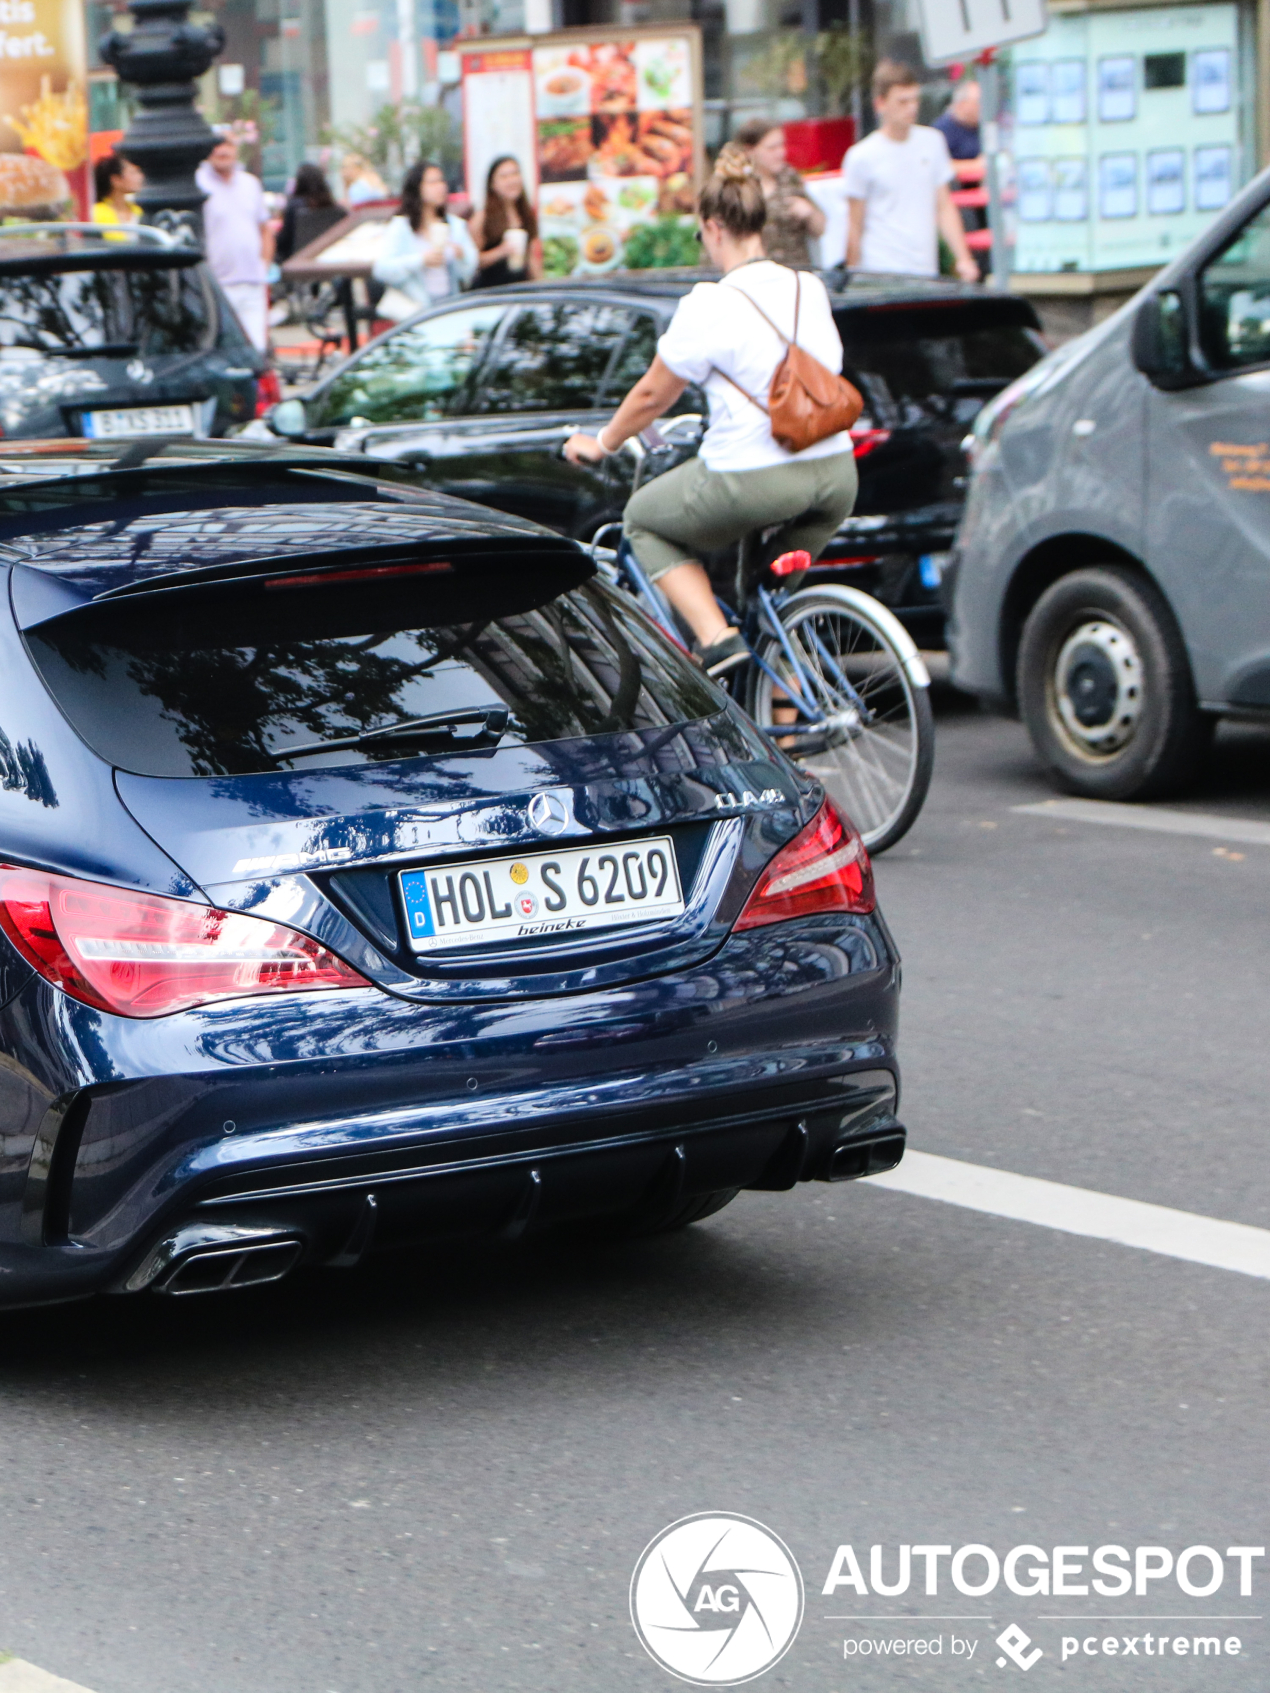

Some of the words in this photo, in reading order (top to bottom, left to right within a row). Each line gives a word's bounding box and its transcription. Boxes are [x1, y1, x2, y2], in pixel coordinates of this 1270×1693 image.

[430, 870, 512, 926] HOL
[540, 861, 568, 911] S
[577, 849, 668, 906] 6209
[415, 911, 426, 927] D
[517, 918, 587, 937] beineke
